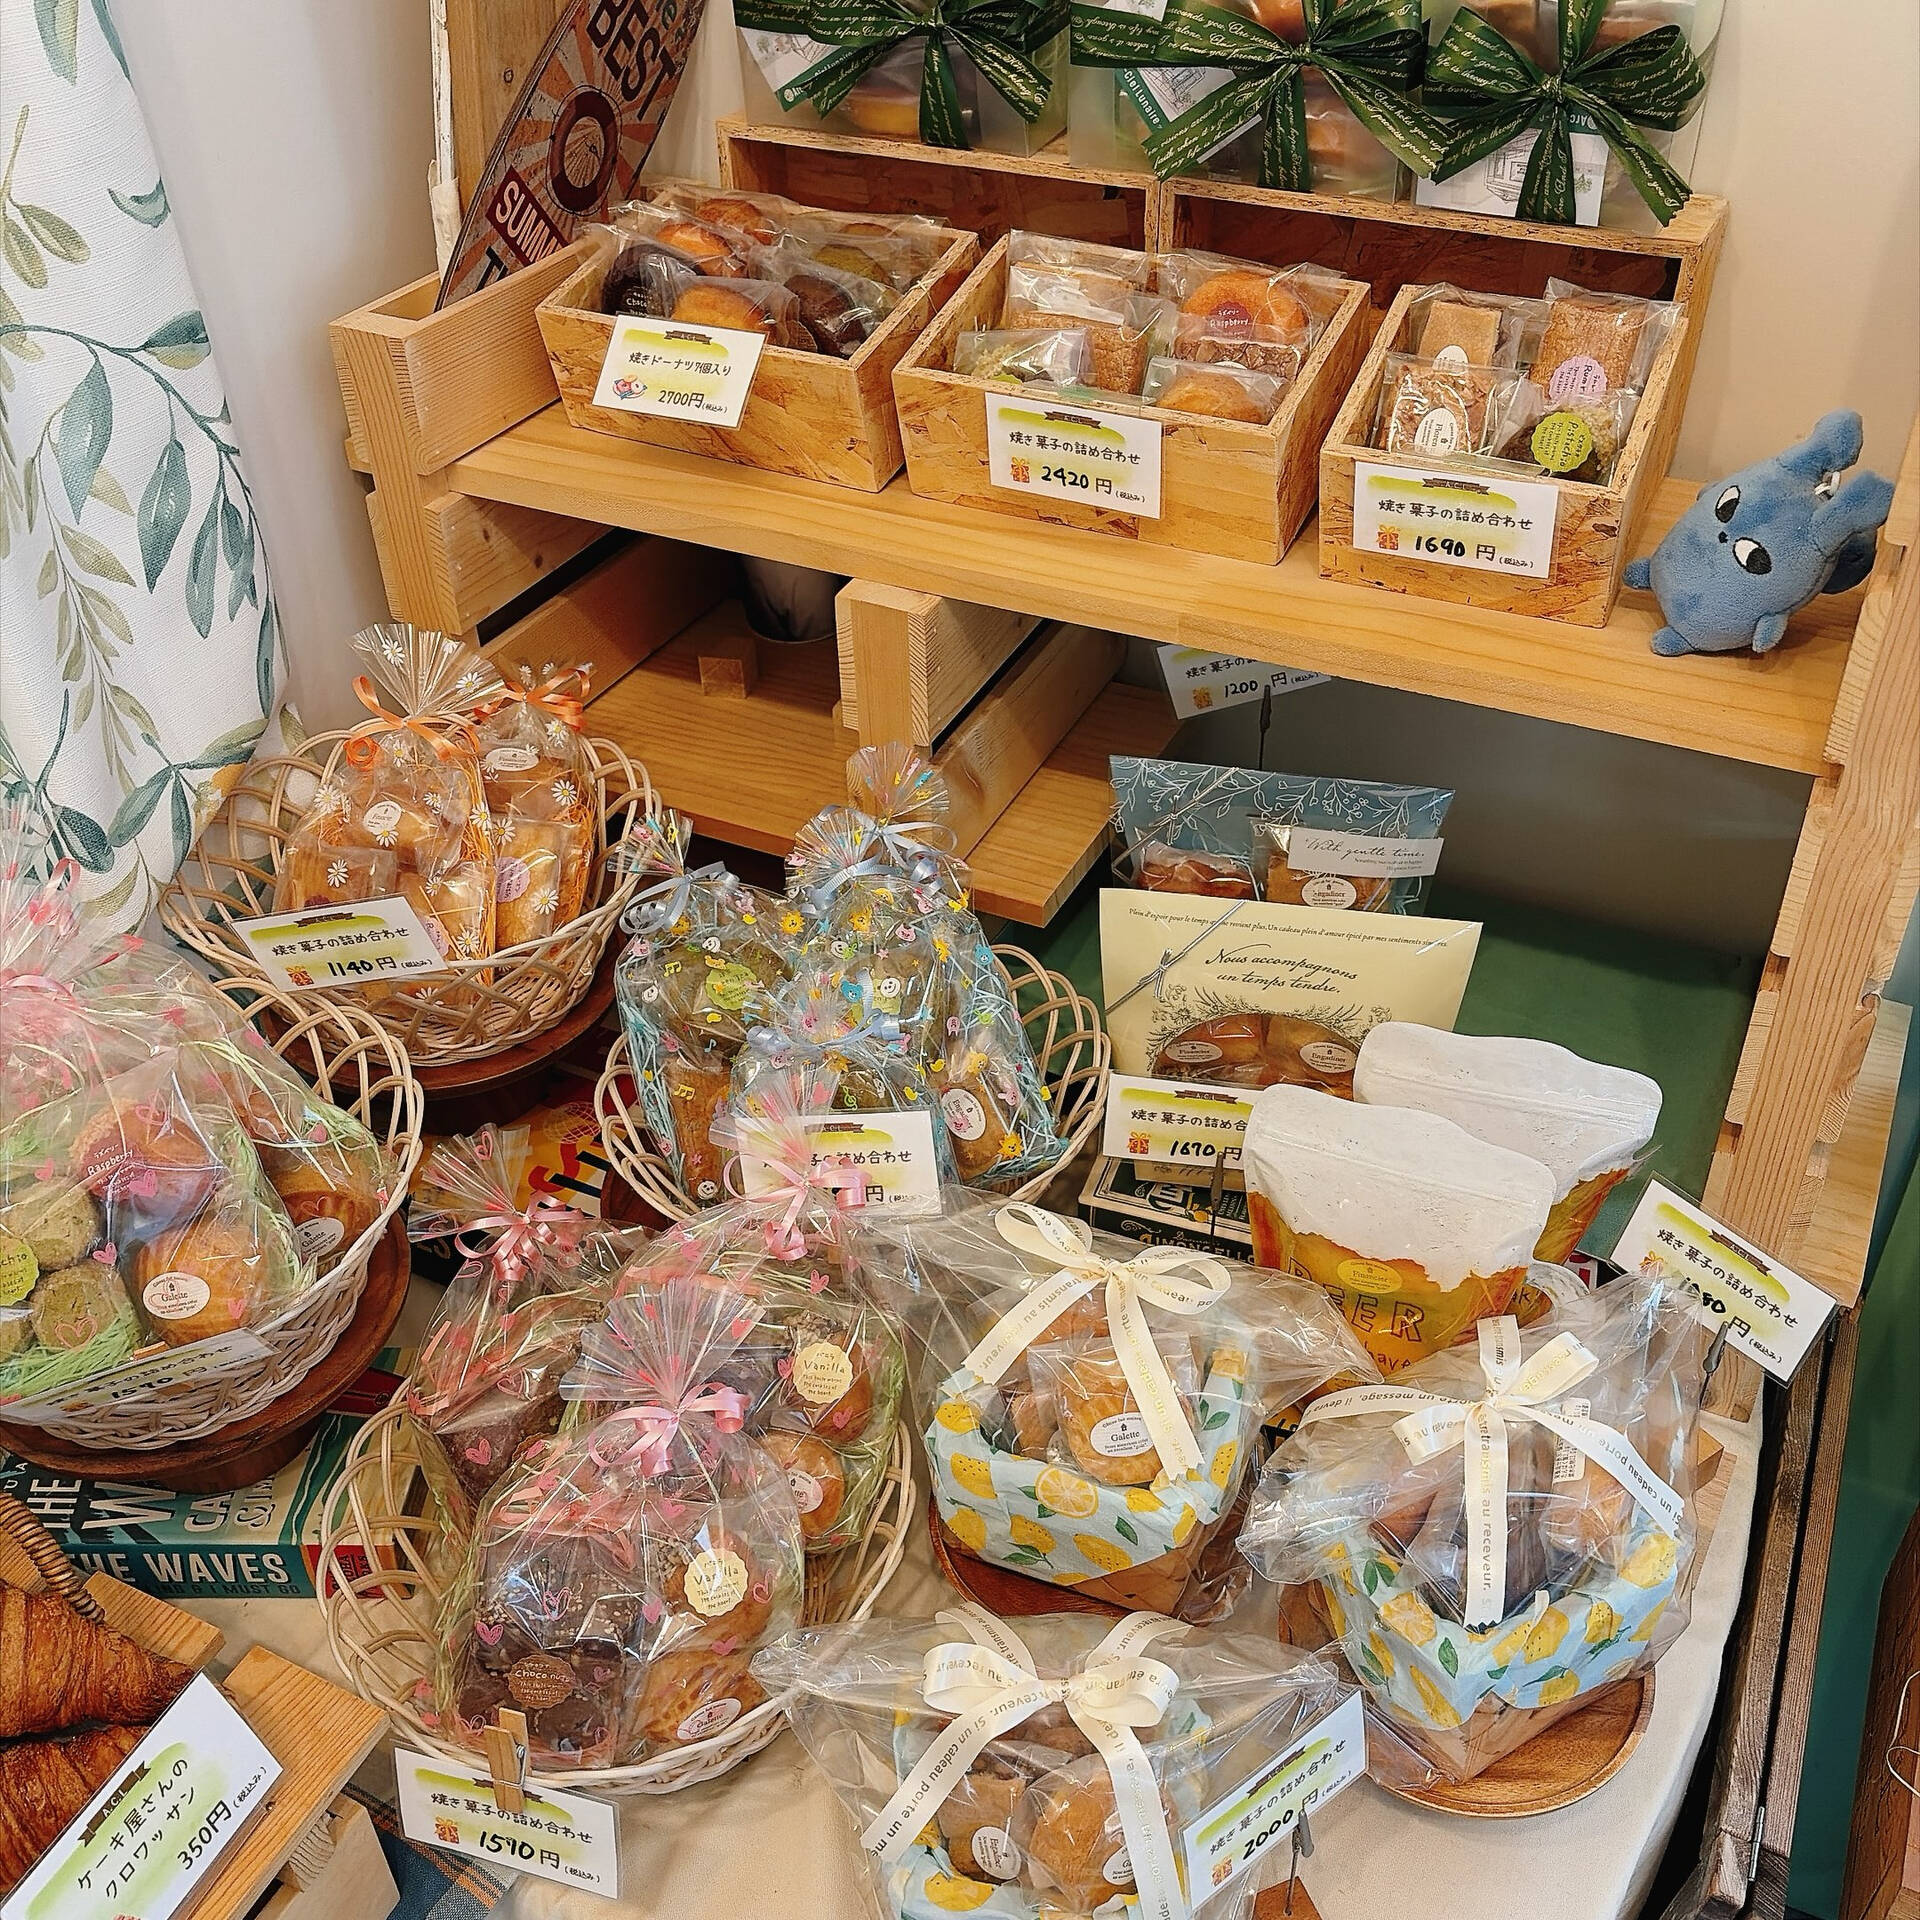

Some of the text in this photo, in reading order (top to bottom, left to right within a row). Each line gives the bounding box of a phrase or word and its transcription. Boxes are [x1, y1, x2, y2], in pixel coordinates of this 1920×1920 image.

[1371, 113, 1420, 157] promise you
[1414, 125, 1429, 141] you
[629, 352, 732, 376] 焼きドーナツ7個入り
[1009, 431, 1141, 465] 焼き菓子の詰め合わせ
[1560, 420, 1579, 467] Pistachio
[1378, 499, 1533, 531] 焼き菓子の詰め合わせ
[1185, 657, 1258, 679] 焼き菓子の
[1340, 846, 1385, 860] gentle
[272, 927, 410, 957] 焼き菓子の詰め合わせ
[1129, 908, 1144, 917] Plein
[1192, 917, 1208, 926] temps
[1278, 925, 1301, 933] cadeau
[1301, 926, 1317, 936] plein
[1318, 928, 1345, 938] d'amour
[1388, 936, 1421, 945] sentiments
[1205, 946, 1358, 980] Nous accompagnons
[1216, 970, 1340, 993] un temps tendre.
[87, 1150, 134, 1176] Raspberry
[1657, 1229, 1798, 1329] 焼き菓子の詰め合わせ
[804, 1359, 845, 1374] Vanilla
[1110, 1431, 1141, 1442] Galette
[1627, 1462, 1658, 1500] cadeau
[143, 1553, 290, 1583] WAVES
[1481, 1518, 1493, 1591] receveur.
[958, 1727, 974, 1745] un
[929, 1744, 961, 1782] cadeau
[899, 1780, 931, 1821] porte
[1210, 1739, 1346, 1856] 焼き菓子の詰め合わせ
[77, 1758, 189, 1891] ケーキ屋さんの
[177, 1799, 233, 1872] 350円
[431, 1793, 593, 1844] 焼き菓子の詰め合わせ
[884, 1819, 904, 1840] un
[105, 1786, 196, 1900] クロワッサン
